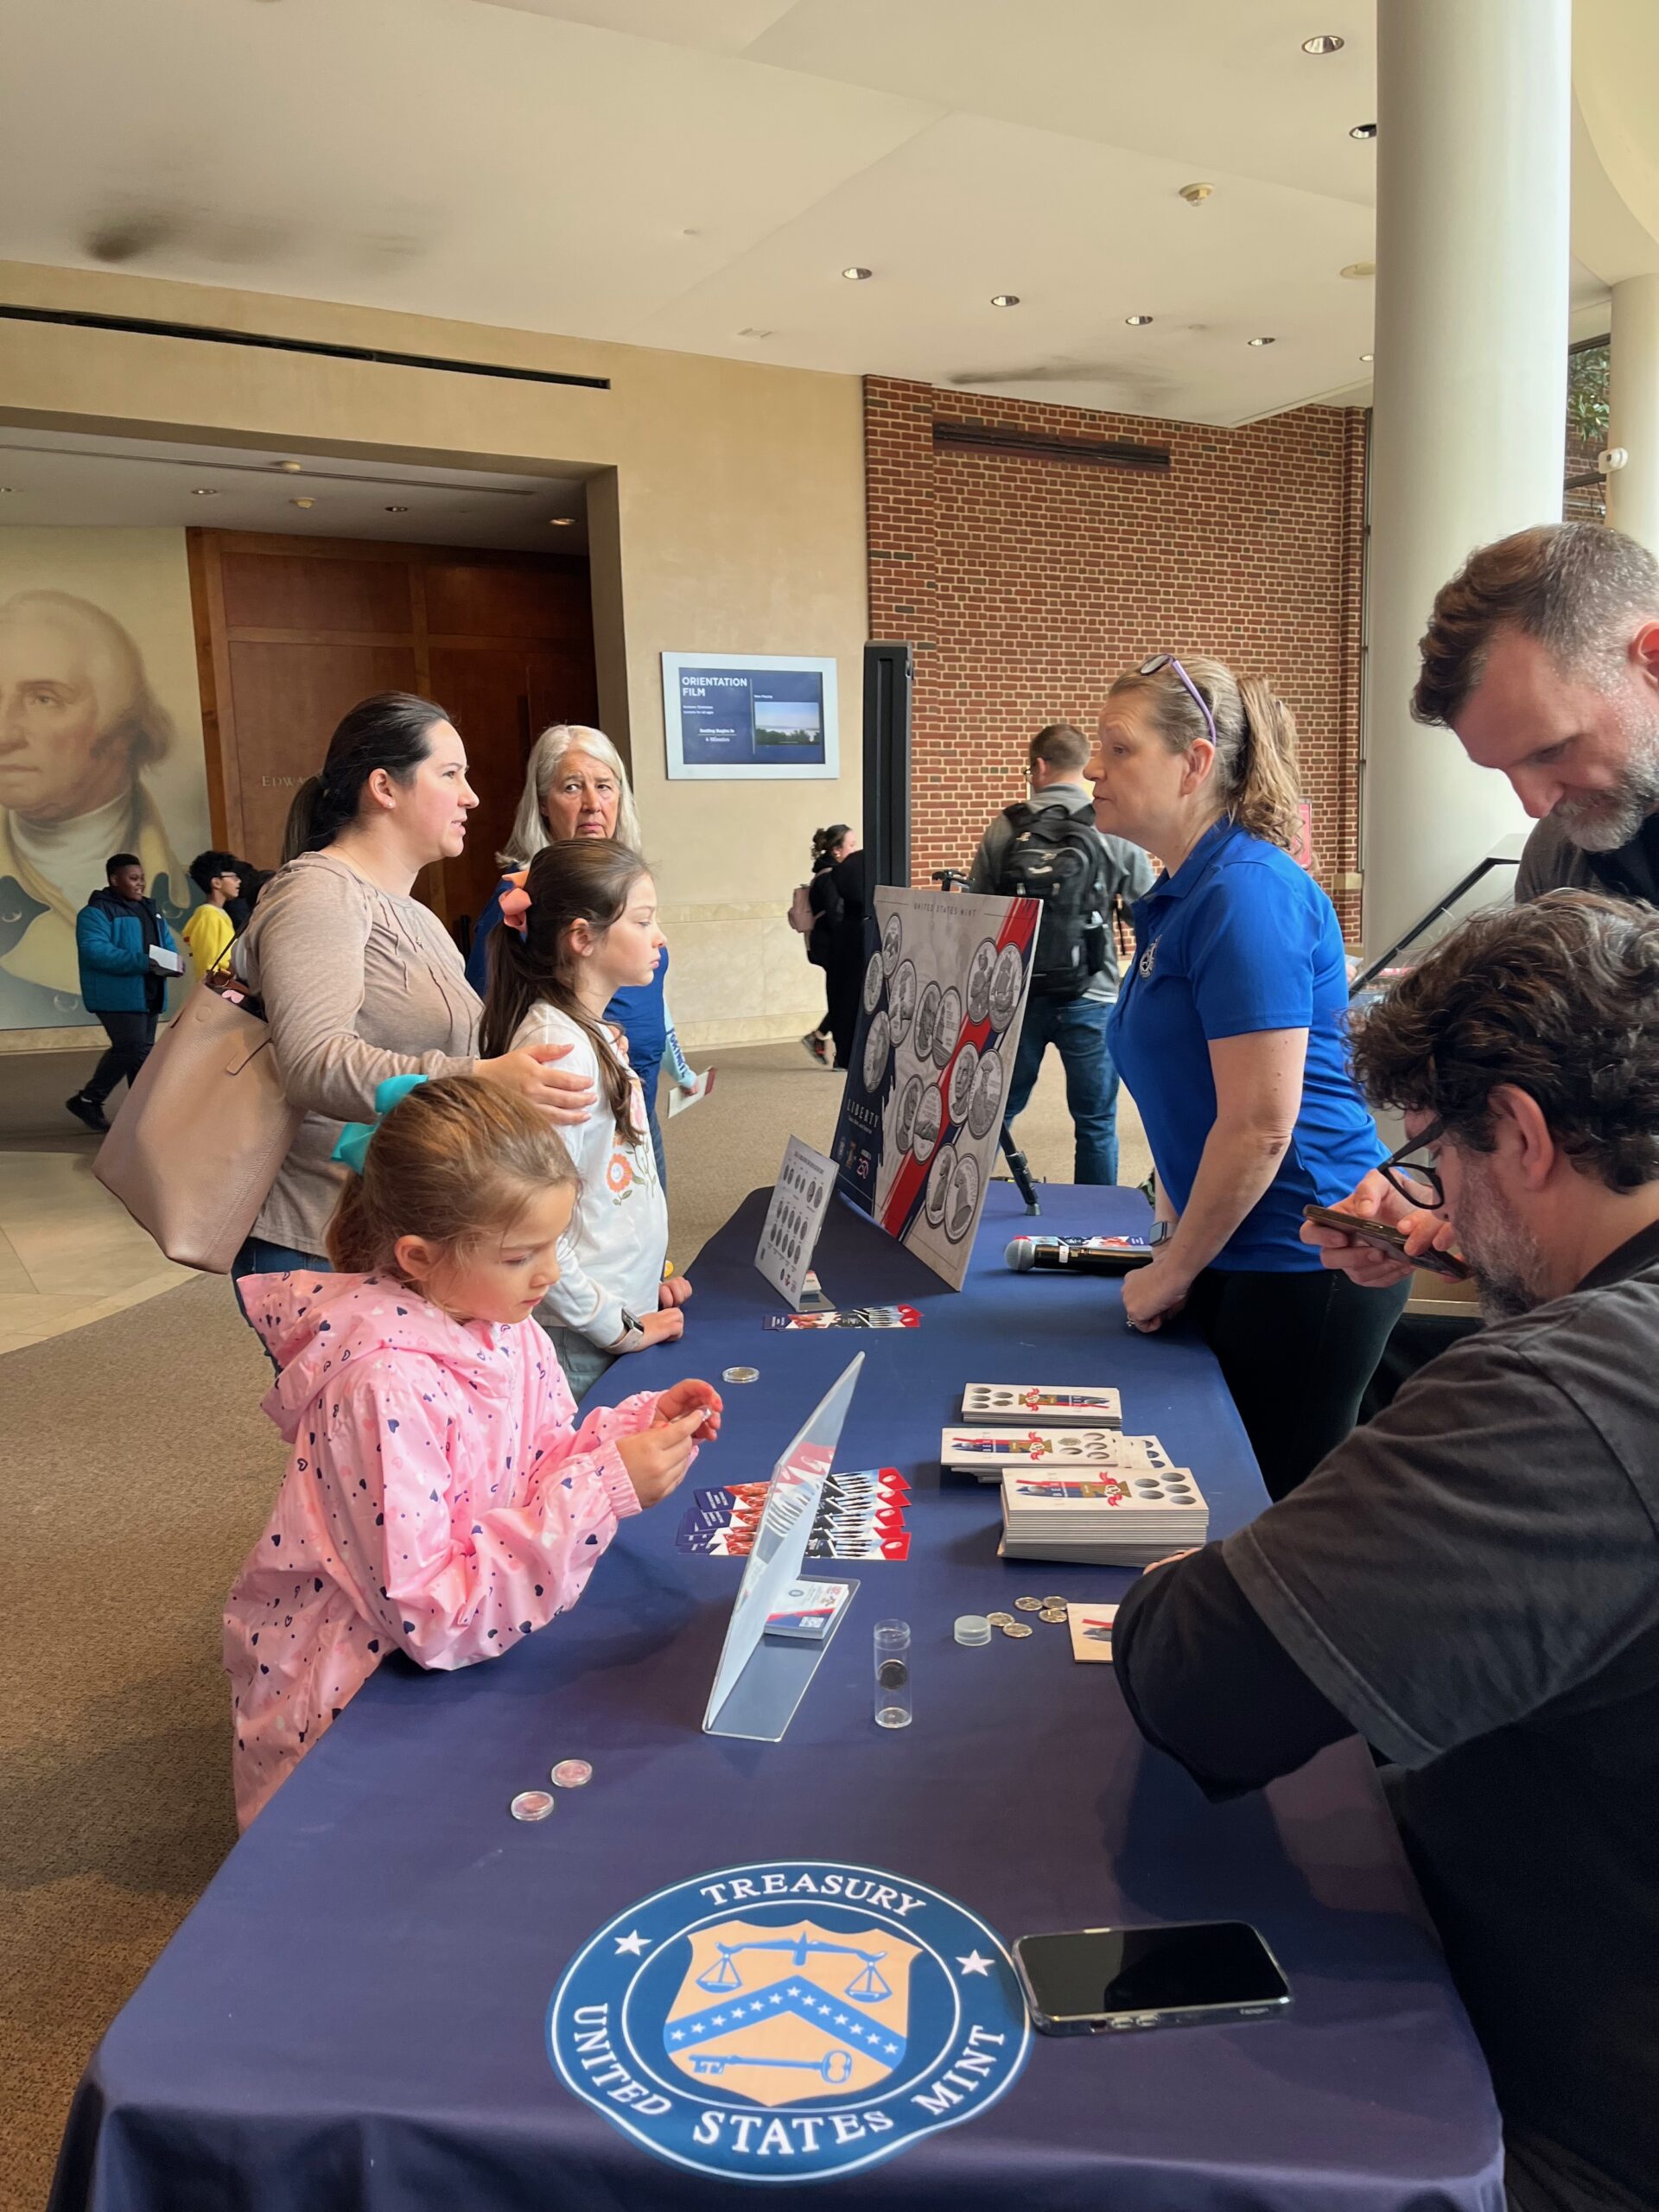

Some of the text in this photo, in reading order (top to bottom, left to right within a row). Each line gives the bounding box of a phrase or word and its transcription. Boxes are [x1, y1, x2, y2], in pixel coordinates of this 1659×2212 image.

[682, 677, 747, 686] ORIENTATION
[682, 688, 706, 696] FILM
[913, 902, 934, 912] UNITED
[936, 905, 957, 915] STATES
[846, 1098, 880, 1128] LIBERTY
[700, 1872, 928, 1917] TREASURY
[574, 2001, 1005, 2157] UNITED STATES MINT
